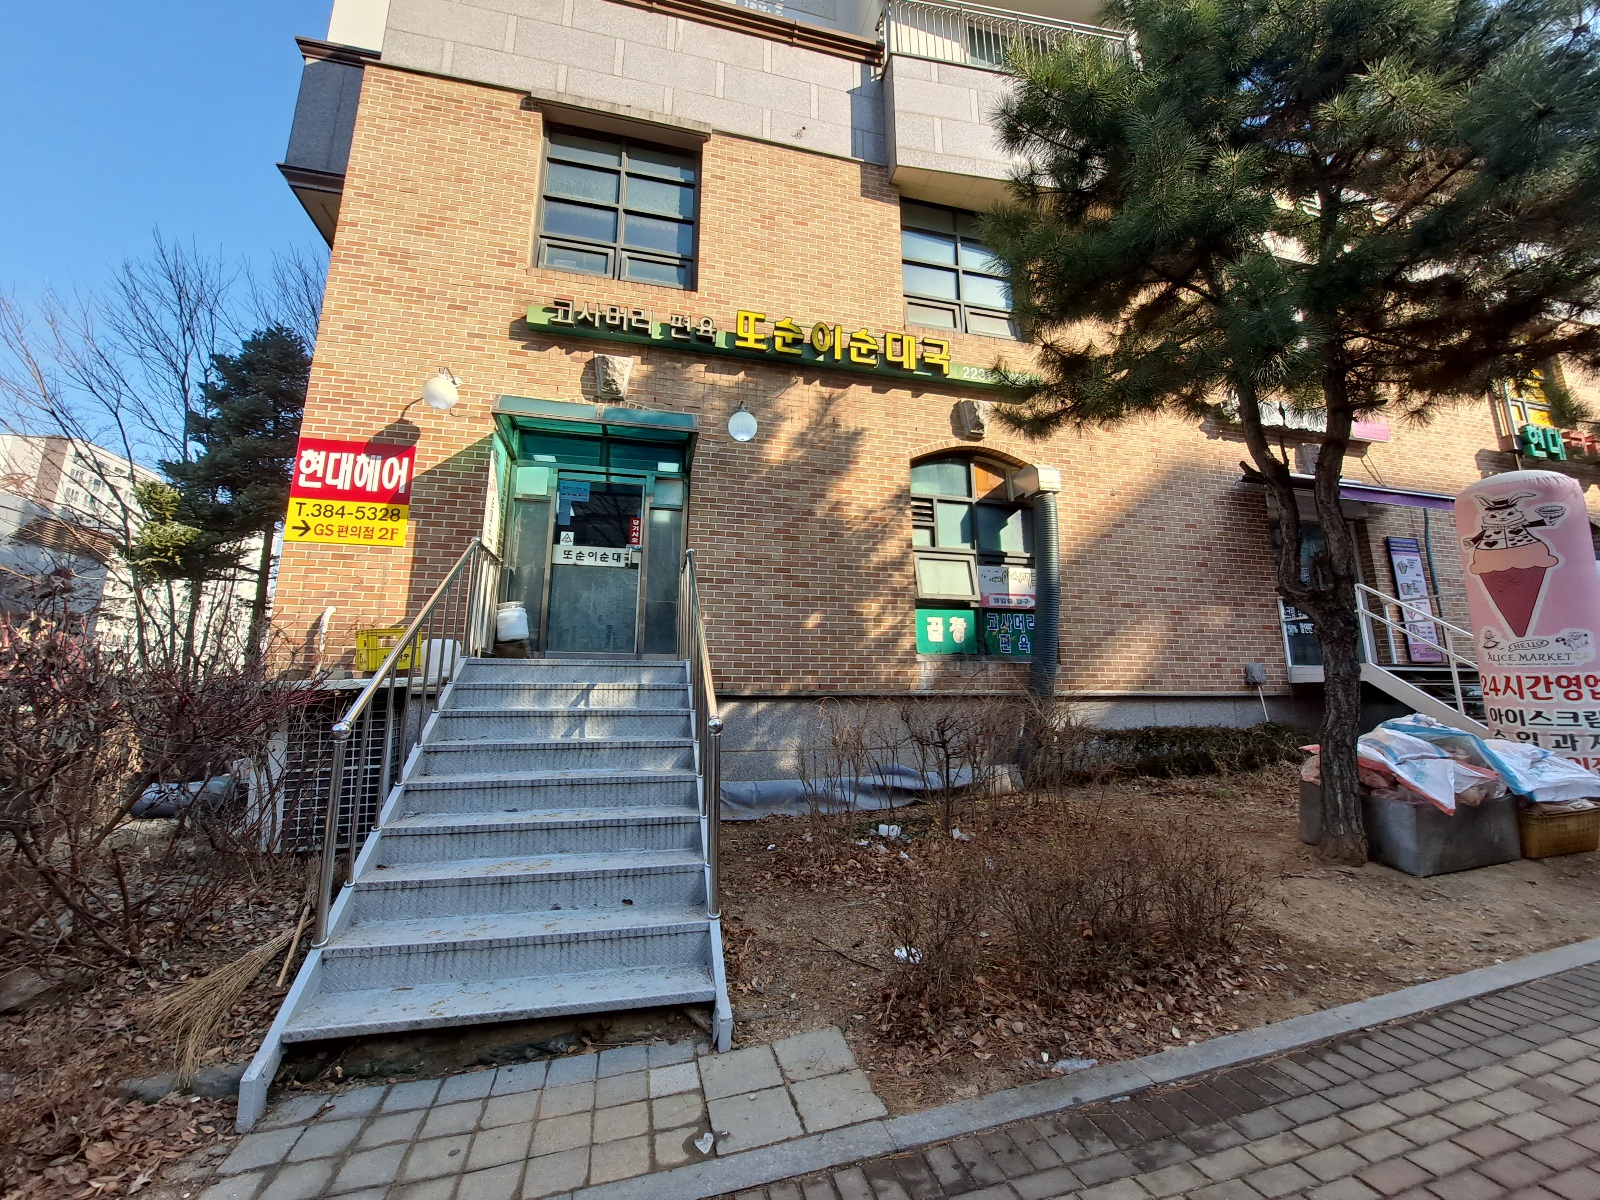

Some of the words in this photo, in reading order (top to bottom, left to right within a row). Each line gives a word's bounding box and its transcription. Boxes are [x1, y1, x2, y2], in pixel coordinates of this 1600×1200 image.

[550, 298, 653, 335] 고사머리
[670, 314, 717, 343] 편육
[735, 310, 950, 375] 또순이순대국
[1525, 423, 1567, 461] 현대
[298, 449, 410, 494] 현대헤어
[296, 502, 401, 522] T.384-5328
[314, 523, 334, 537] GS
[337, 525, 375, 540] 편의점
[378, 527, 399, 541] 2F
[632, 519, 640, 543] 당기시오
[926, 616, 966, 644] 곱창
[999, 634, 1031, 654] 편육
[1487, 653, 1515, 662] ALICE
[1519, 653, 1572, 661] MARKET
[1489, 707, 1600, 729] 아이스크림
